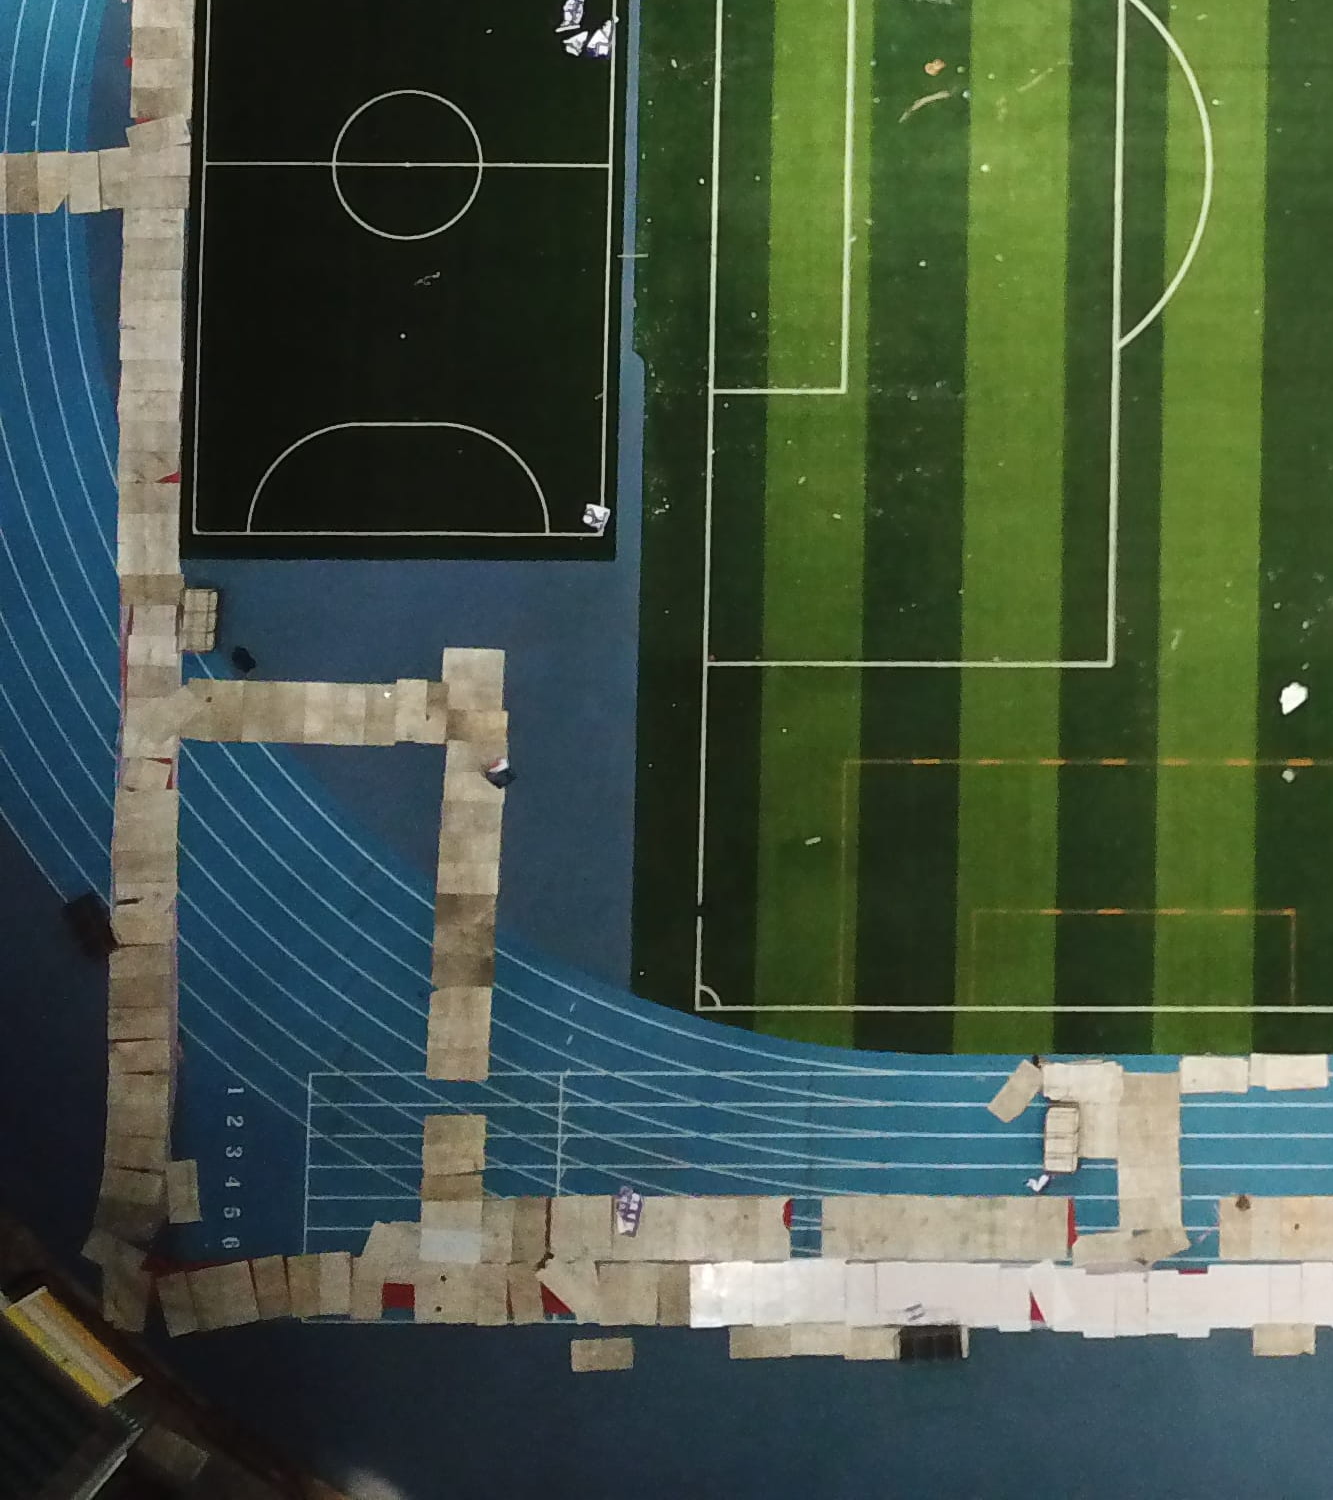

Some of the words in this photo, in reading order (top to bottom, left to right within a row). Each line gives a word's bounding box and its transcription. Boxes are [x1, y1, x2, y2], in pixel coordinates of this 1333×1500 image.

[227, 1087, 245, 1095] 1
[226, 1115, 244, 1127] 2
[225, 1146, 243, 1158] 3
[225, 1176, 241, 1188] 4
[223, 1207, 241, 1219] 5
